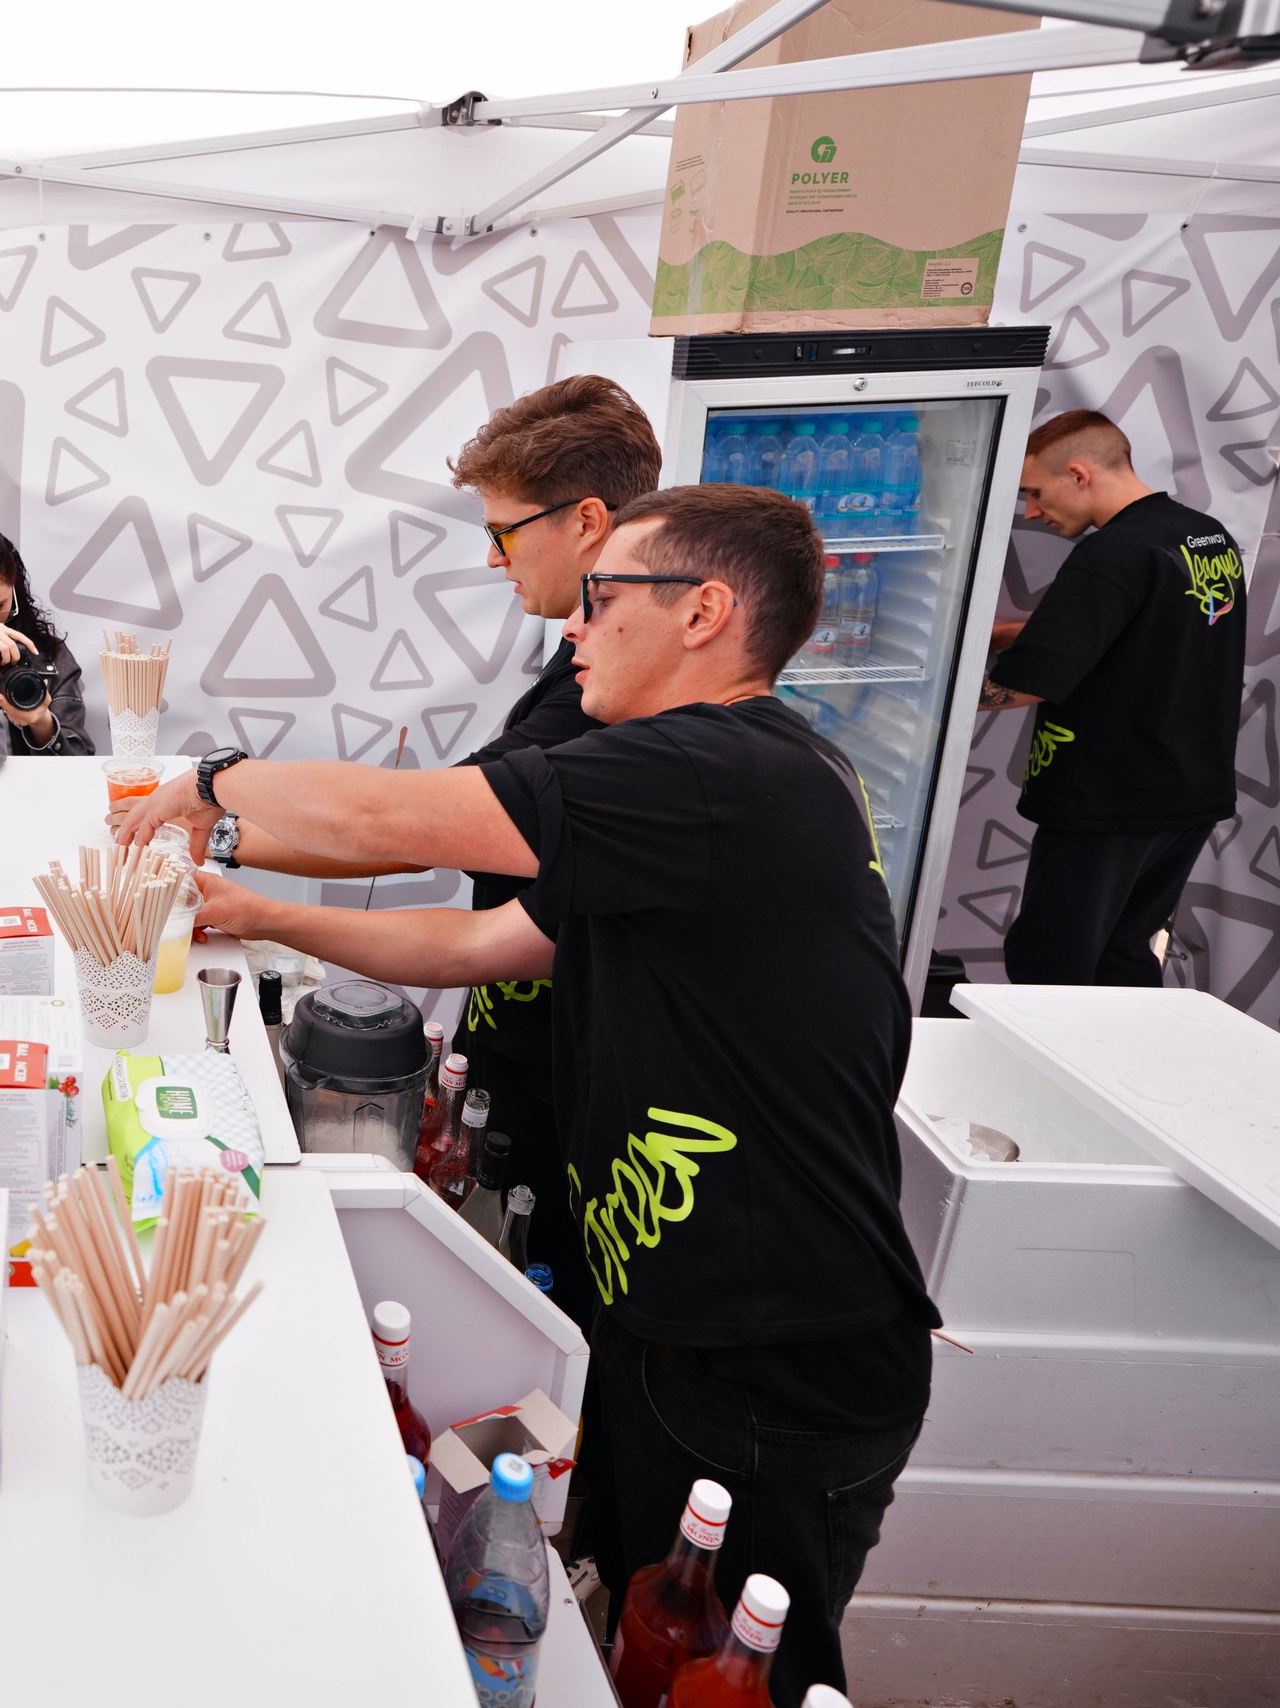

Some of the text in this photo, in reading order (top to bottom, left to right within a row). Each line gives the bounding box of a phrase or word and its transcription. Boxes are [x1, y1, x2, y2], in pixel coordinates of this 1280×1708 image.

[791, 172, 850, 185] POLYER
[1186, 533, 1226, 549] Greenway
[166, 1090, 194, 1115] HOME
[686, 1524, 721, 1544] MONIN
